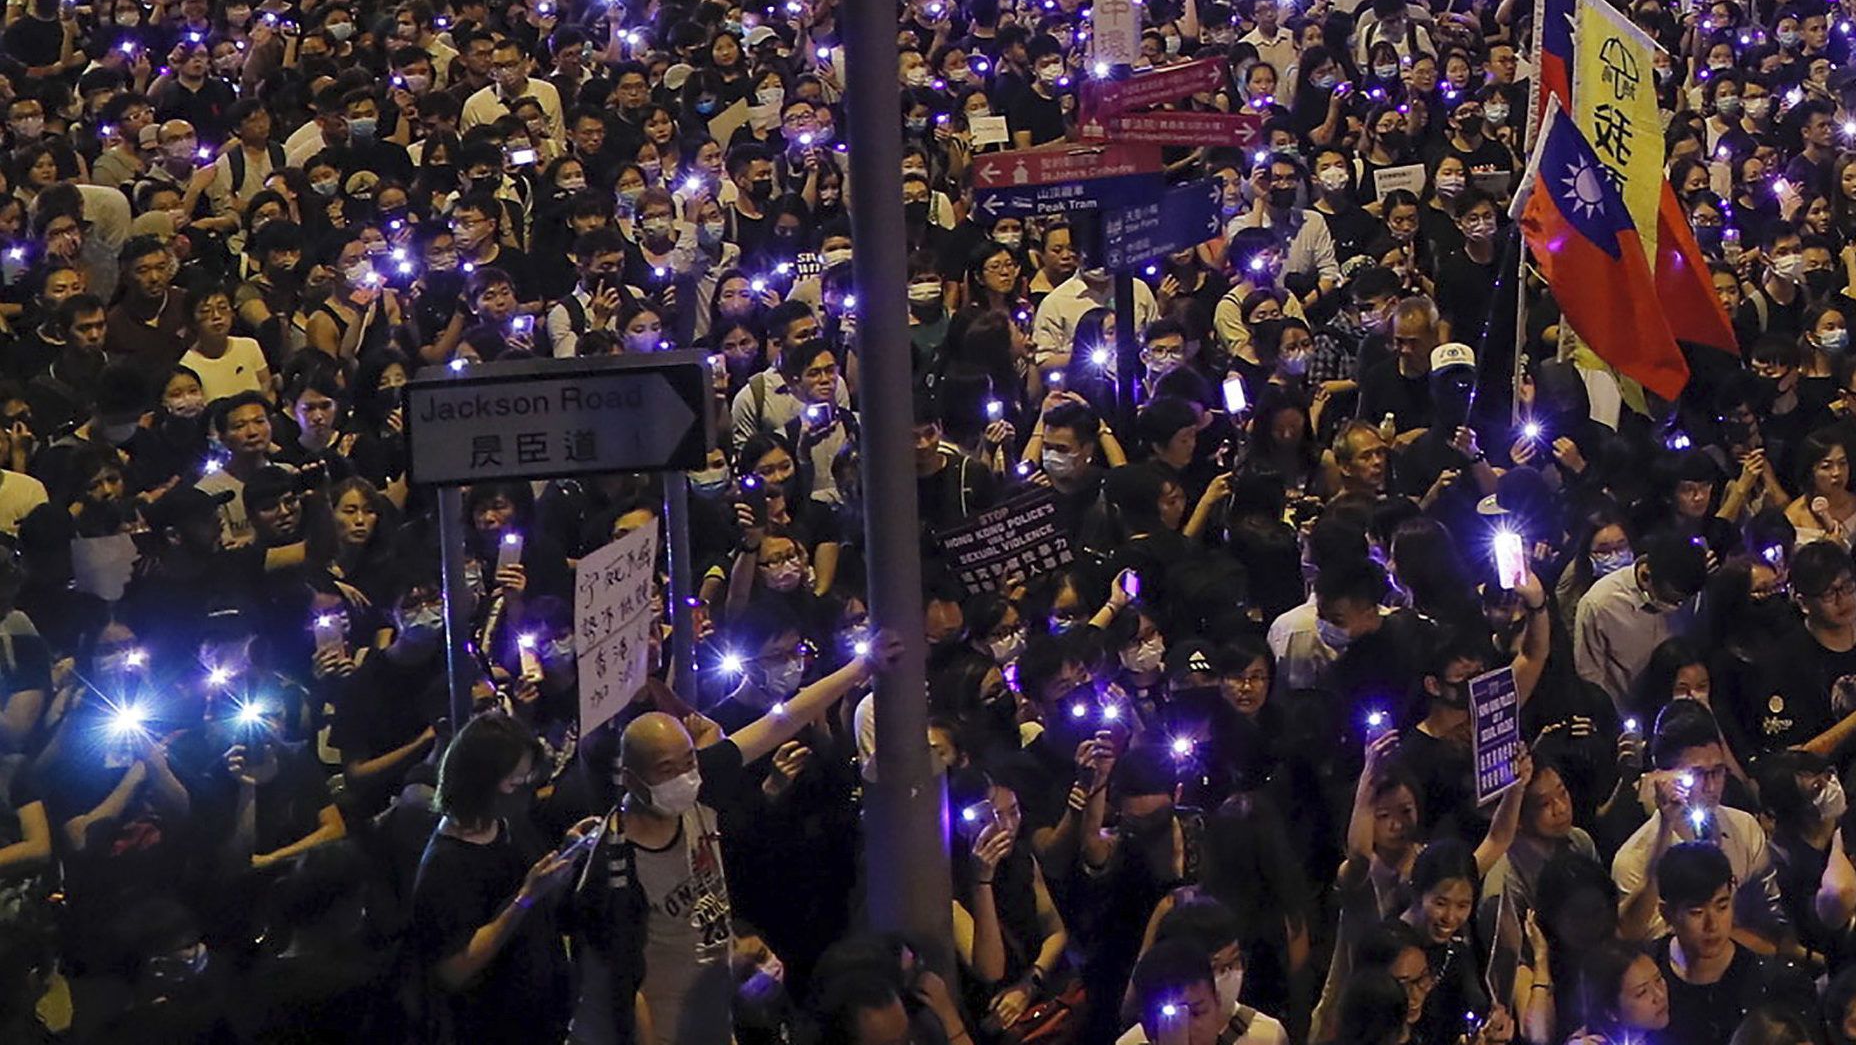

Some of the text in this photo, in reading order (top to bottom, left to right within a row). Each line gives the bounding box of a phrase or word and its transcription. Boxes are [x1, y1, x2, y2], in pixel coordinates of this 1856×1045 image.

[1037, 199, 1098, 213] Peak Tram
[420, 383, 643, 423] Jackson Road
[470, 427, 599, 471] 昃臣道
[943, 502, 1056, 549] HONG KONG POLICE'S
[978, 506, 1010, 526] STOP
[959, 522, 1056, 565] SEXUAL VIOLENCE
